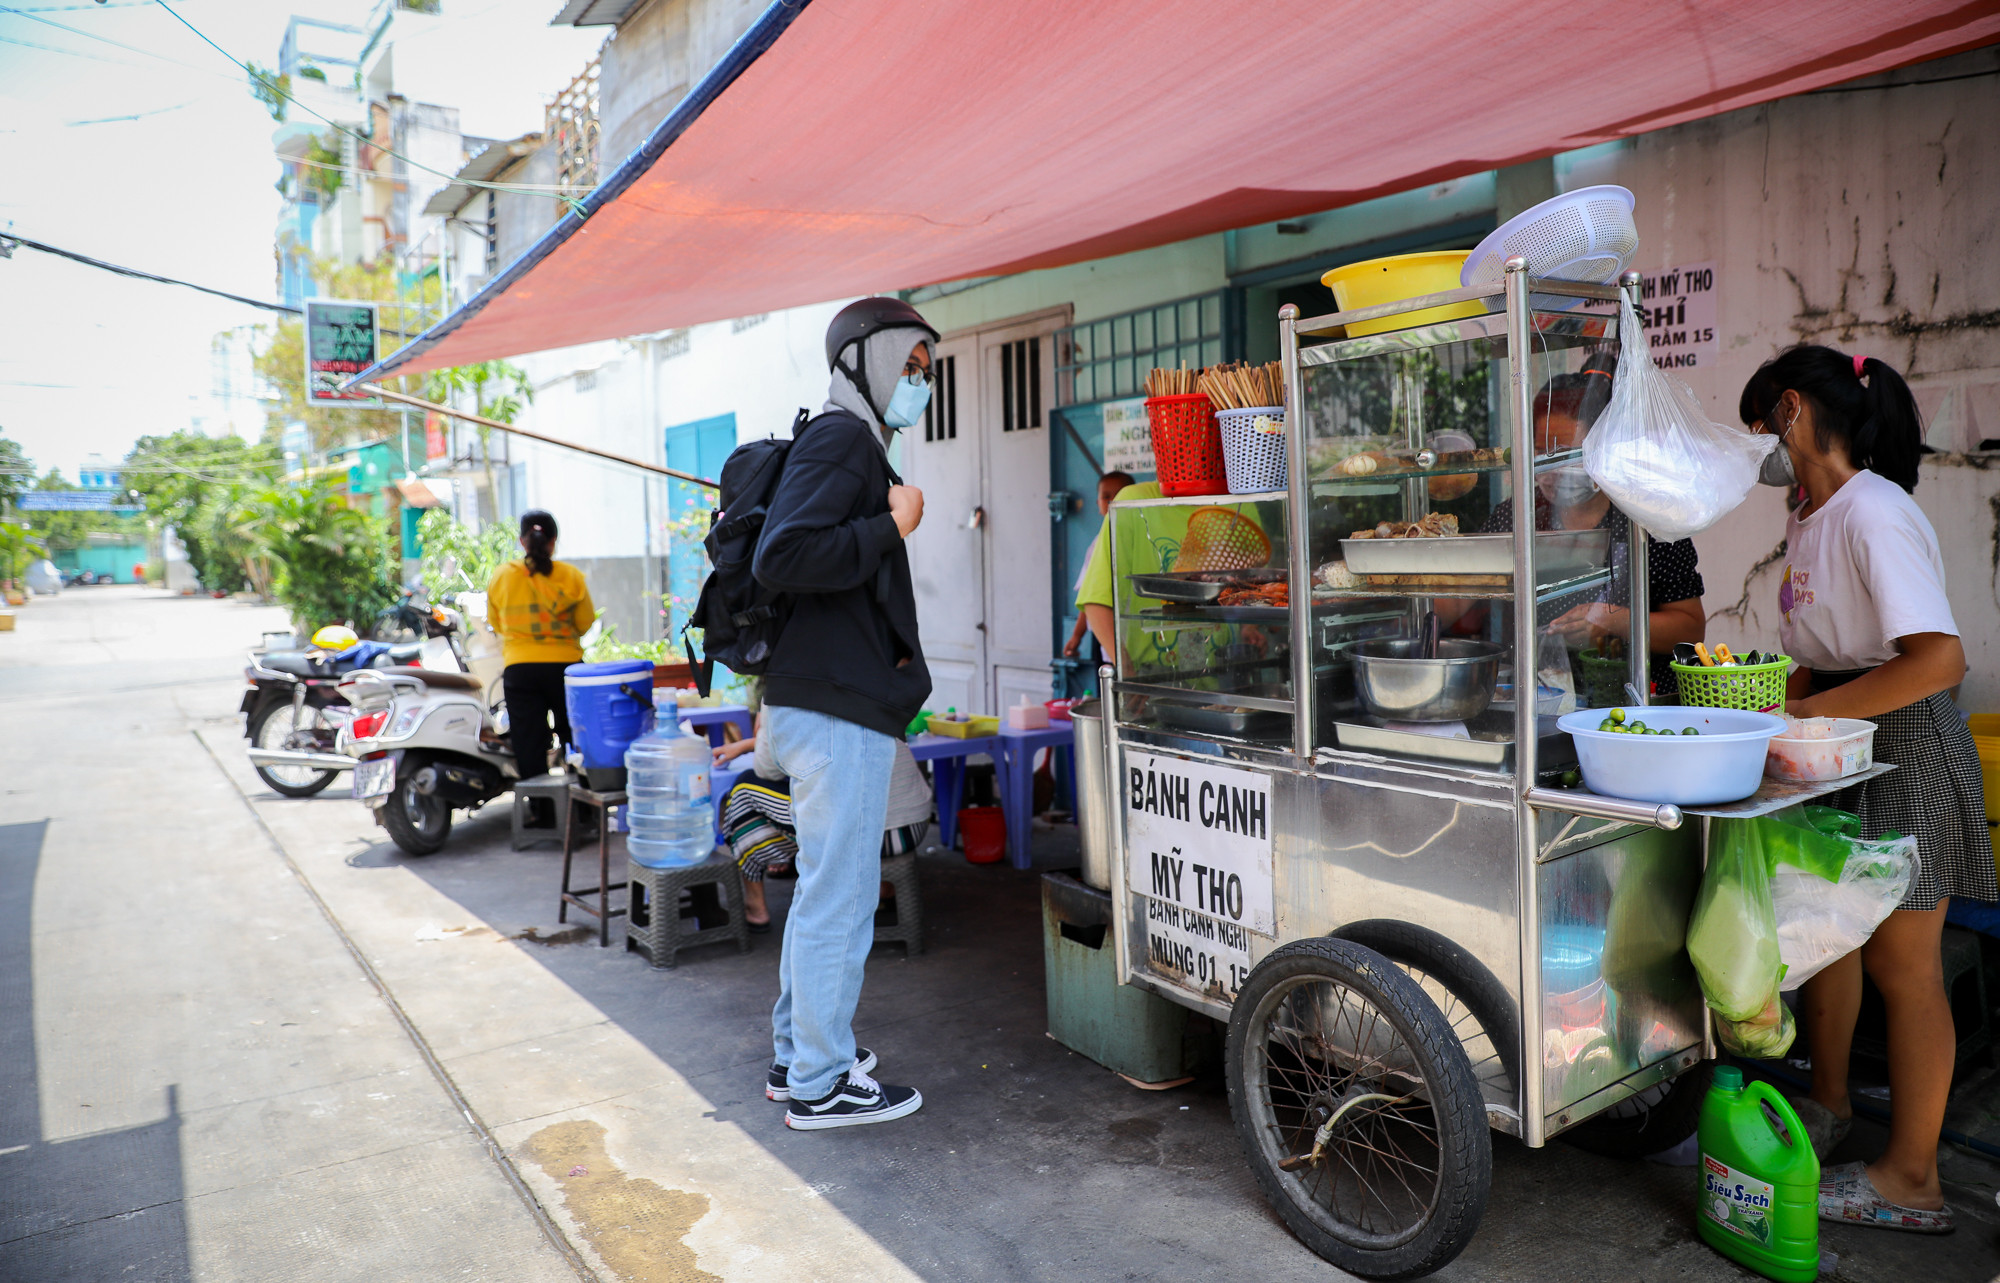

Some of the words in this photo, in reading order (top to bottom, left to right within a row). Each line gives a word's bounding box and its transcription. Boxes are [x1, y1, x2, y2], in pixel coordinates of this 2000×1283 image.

[1660, 268, 1680, 297] MỸ
[1684, 268, 1713, 294] THO
[1642, 296, 1687, 329] GHỈ
[1693, 328, 1713, 343] 15
[1653, 351, 1697, 369] HÁNG
[1120, 426, 1152, 442] NGH
[1130, 759, 1190, 822] BÁNH
[1199, 780, 1266, 840] CANH
[1151, 846, 1184, 902] MỸ
[1192, 863, 1243, 920] THO
[1183, 909, 1214, 940] CANH
[1151, 930, 1194, 977] MÙNG
[1706, 1173, 1732, 1198] Siêu
[1734, 1184, 1769, 1207] Sạch
